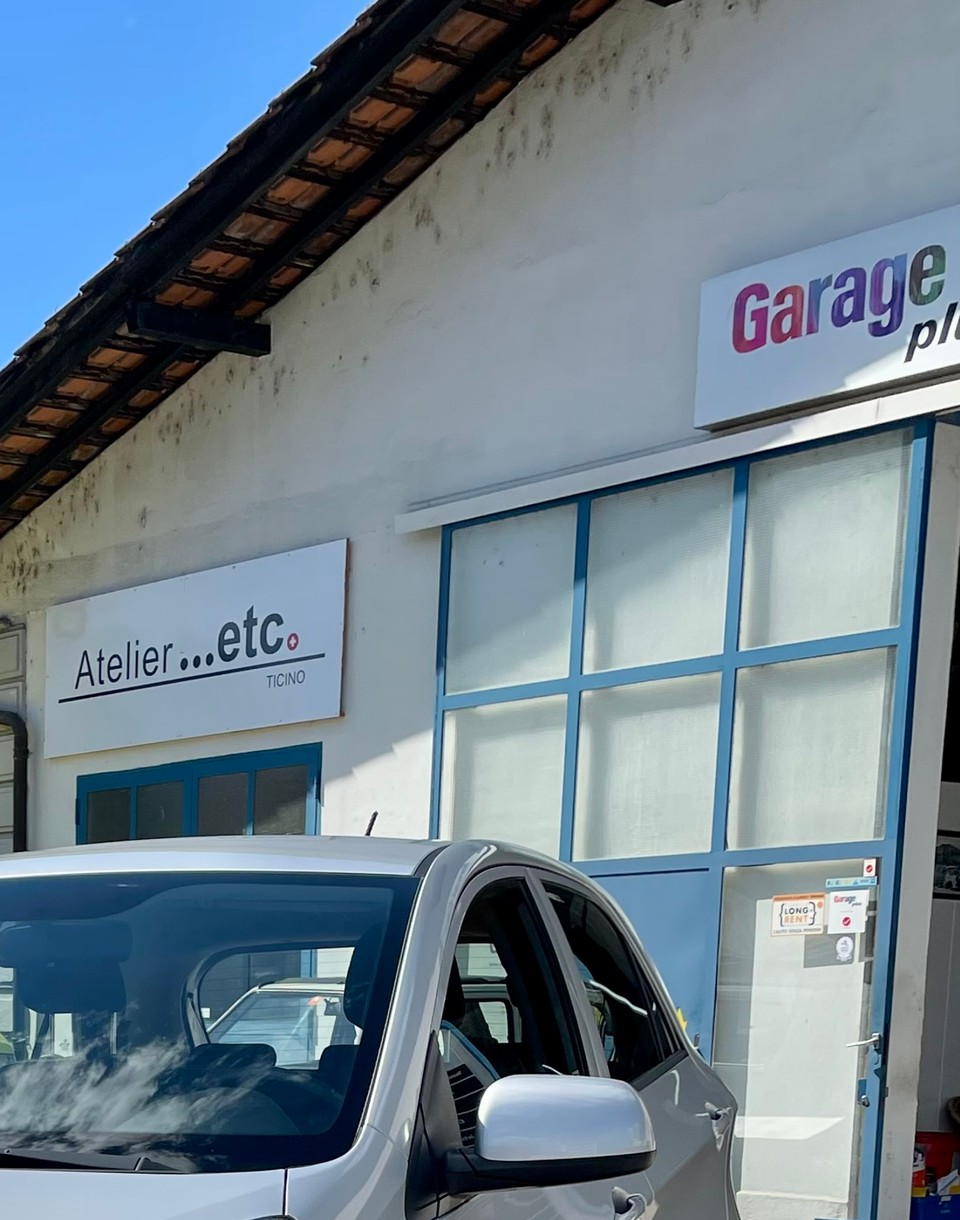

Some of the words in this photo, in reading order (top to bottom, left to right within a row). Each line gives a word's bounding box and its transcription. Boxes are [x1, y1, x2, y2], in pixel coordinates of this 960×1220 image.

[732, 244, 947, 354] Garage
[904, 301, 960, 363] pl
[74, 640, 174, 689] Atelier
[266, 669, 306, 689] TICINO
[784, 906, 809, 915] LONG
[784, 915, 809, 924] RENT
